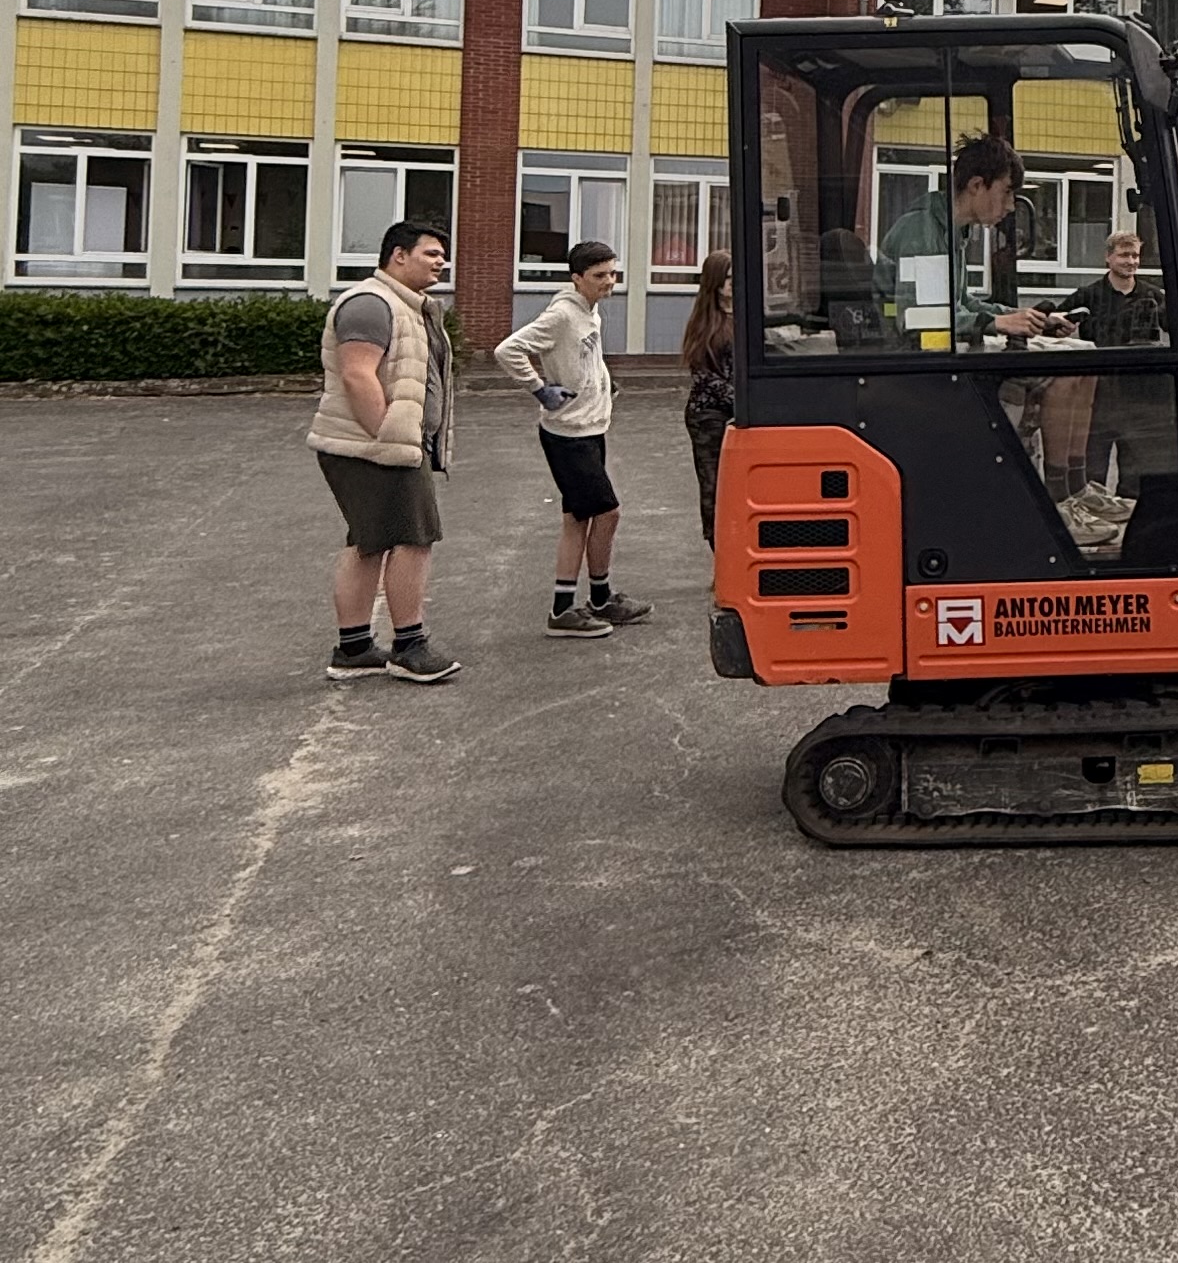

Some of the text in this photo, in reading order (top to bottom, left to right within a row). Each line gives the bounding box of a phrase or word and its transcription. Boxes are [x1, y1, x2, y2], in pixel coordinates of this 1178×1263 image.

[995, 594, 1150, 619] ANTON MEYER
[994, 617, 1151, 638] BAUUNTERNEHMEN
